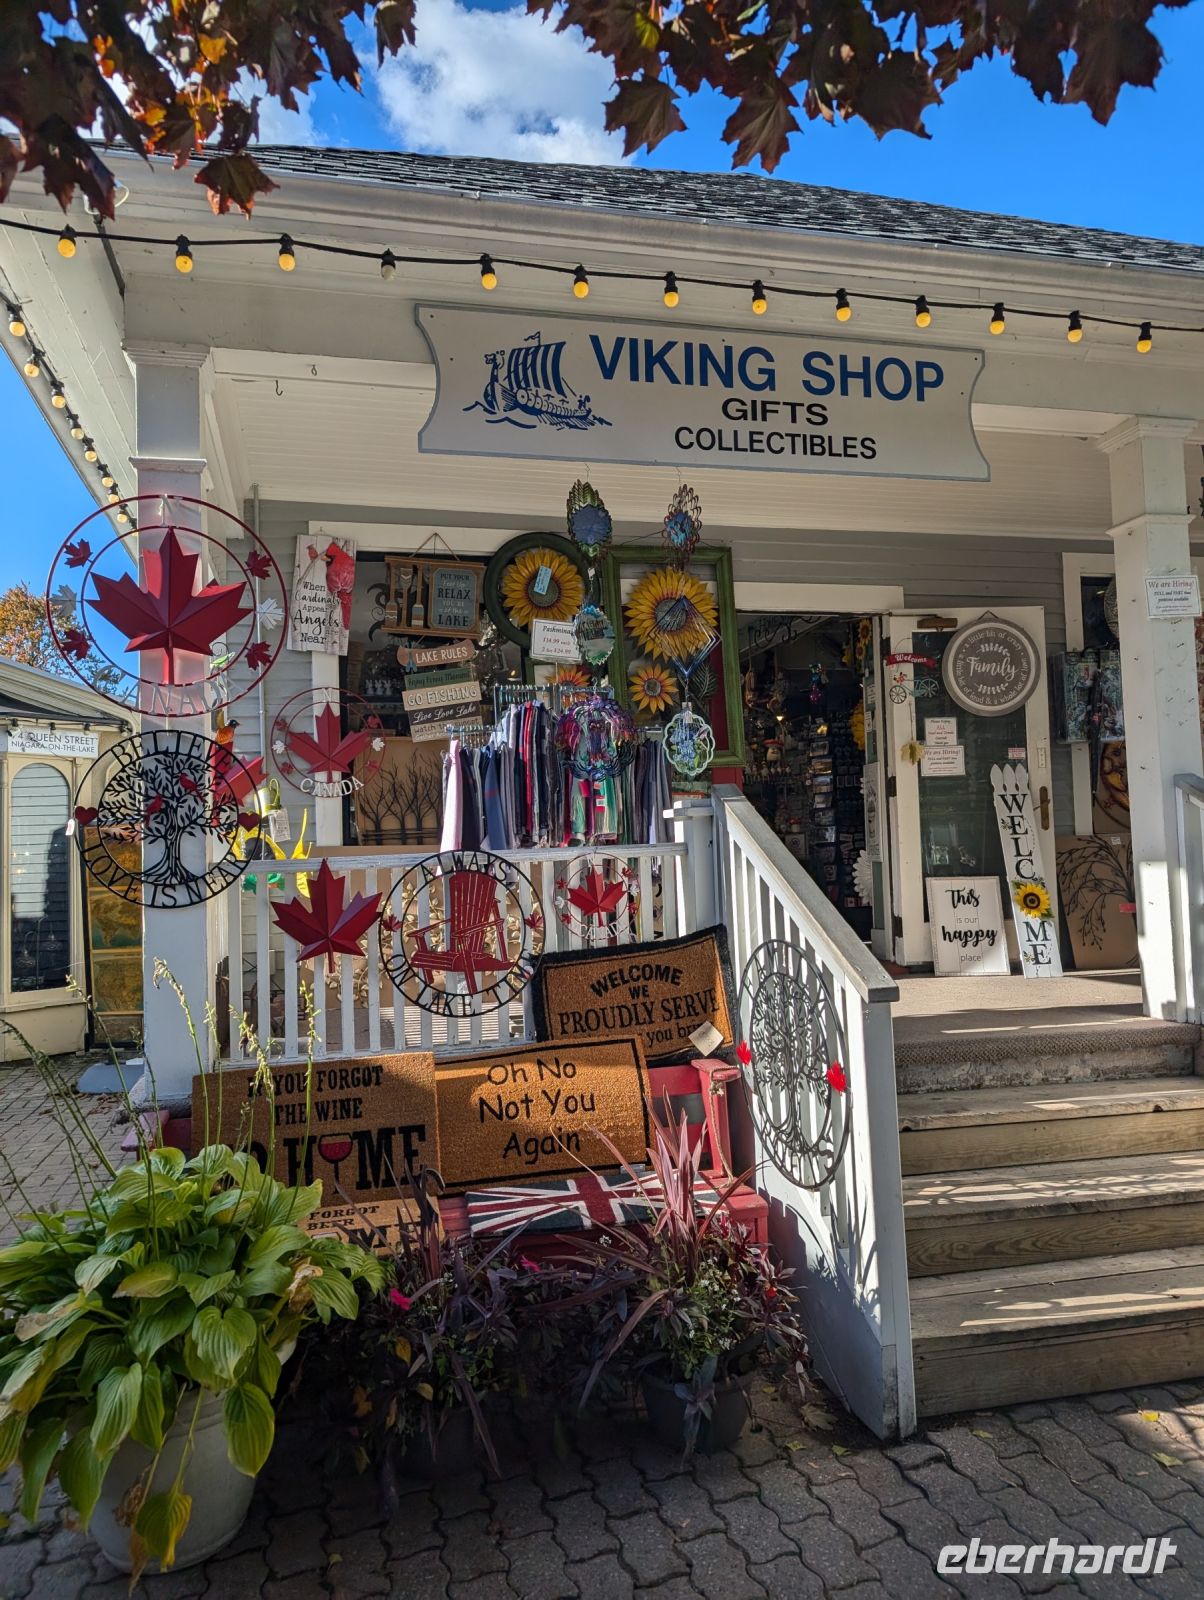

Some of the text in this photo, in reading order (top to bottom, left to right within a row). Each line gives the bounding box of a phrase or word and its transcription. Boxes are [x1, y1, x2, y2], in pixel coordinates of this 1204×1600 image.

[589, 333, 945, 403] VIKING SHOP
[721, 397, 829, 426] GIFTS
[674, 426, 878, 461] COLLECTIBLES
[303, 581, 326, 592] When
[437, 588, 471, 600] RELAX
[303, 604, 329, 612] Appear
[294, 609, 340, 635] Angels
[437, 614, 470, 627] LAKE
[300, 632, 328, 645] Near
[415, 646, 468, 664] LAKE RULES
[966, 656, 1020, 682] Family
[408, 685, 477, 706] GO FISHING
[413, 703, 477, 723] Live Love Lake
[27, 732, 62, 743] QUEEN
[64, 735, 96, 746] STREET
[110, 730, 232, 769] BELIEVE
[300, 776, 364, 797] CANADA
[81, 844, 247, 907] LOVE IS NEAR
[421, 851, 509, 884] ALWAYS
[945, 888, 981, 909] This
[942, 925, 998, 948] happy
[961, 954, 982, 962] place
[387, 948, 534, 1015] ON LAKE TIME
[590, 963, 683, 998] WELCOME
[628, 984, 650, 999] WE
[558, 1000, 656, 1036] PROUDLY
[660, 988, 720, 1022] SERVE
[646, 1028, 673, 1049] you
[273, 1071, 308, 1096] YOU
[316, 1065, 384, 1093] FORGOT
[486, 1056, 577, 1086] Oh No
[275, 1098, 364, 1126] THE WINE
[478, 1088, 596, 1123] Not You
[503, 1126, 582, 1165] Again
[308, 1205, 380, 1221] FORGOT
